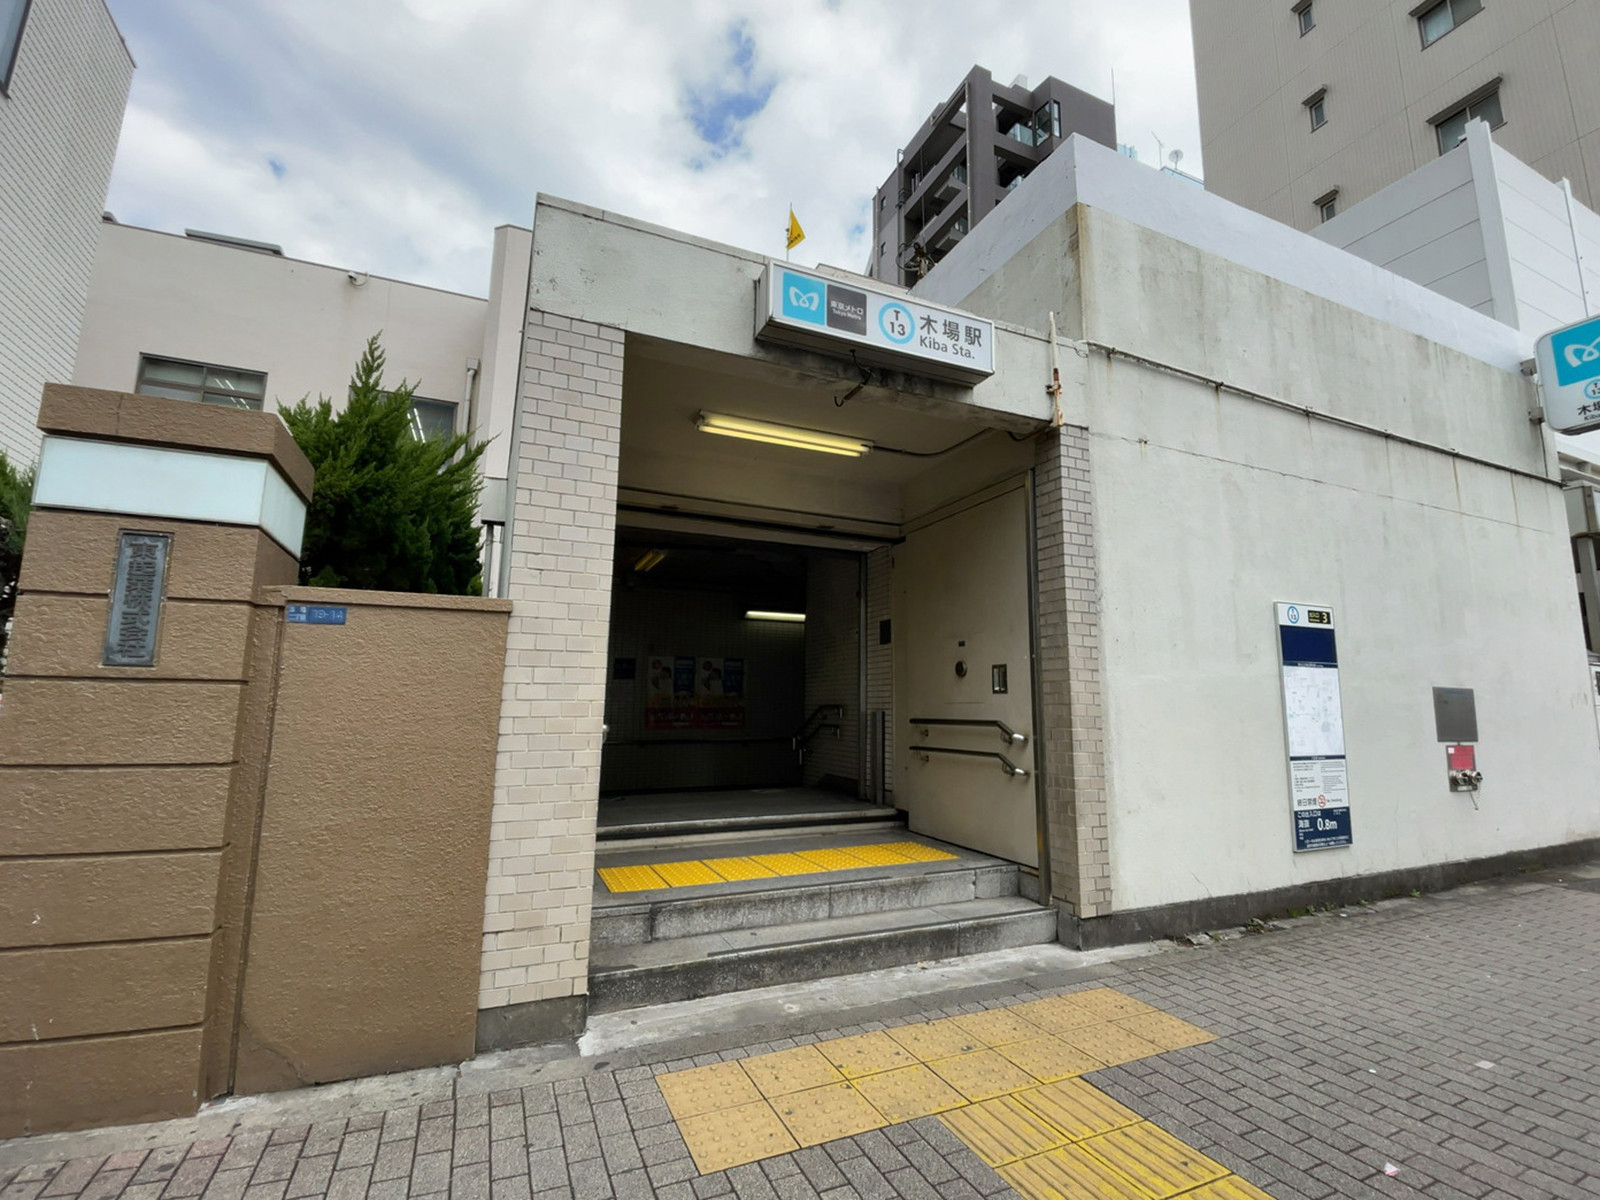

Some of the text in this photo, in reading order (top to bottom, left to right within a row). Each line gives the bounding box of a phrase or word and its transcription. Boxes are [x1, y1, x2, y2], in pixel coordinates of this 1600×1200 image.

[830, 300, 864, 315] 東京メトロ
[893, 309, 902, 321] T
[889, 322, 906, 337] 13
[919, 314, 983, 348] 木場駅
[919, 335, 975, 360] Kiba Sta.
[1321, 612, 1328, 623] 3
[1317, 818, 1338, 831] 0.8m
